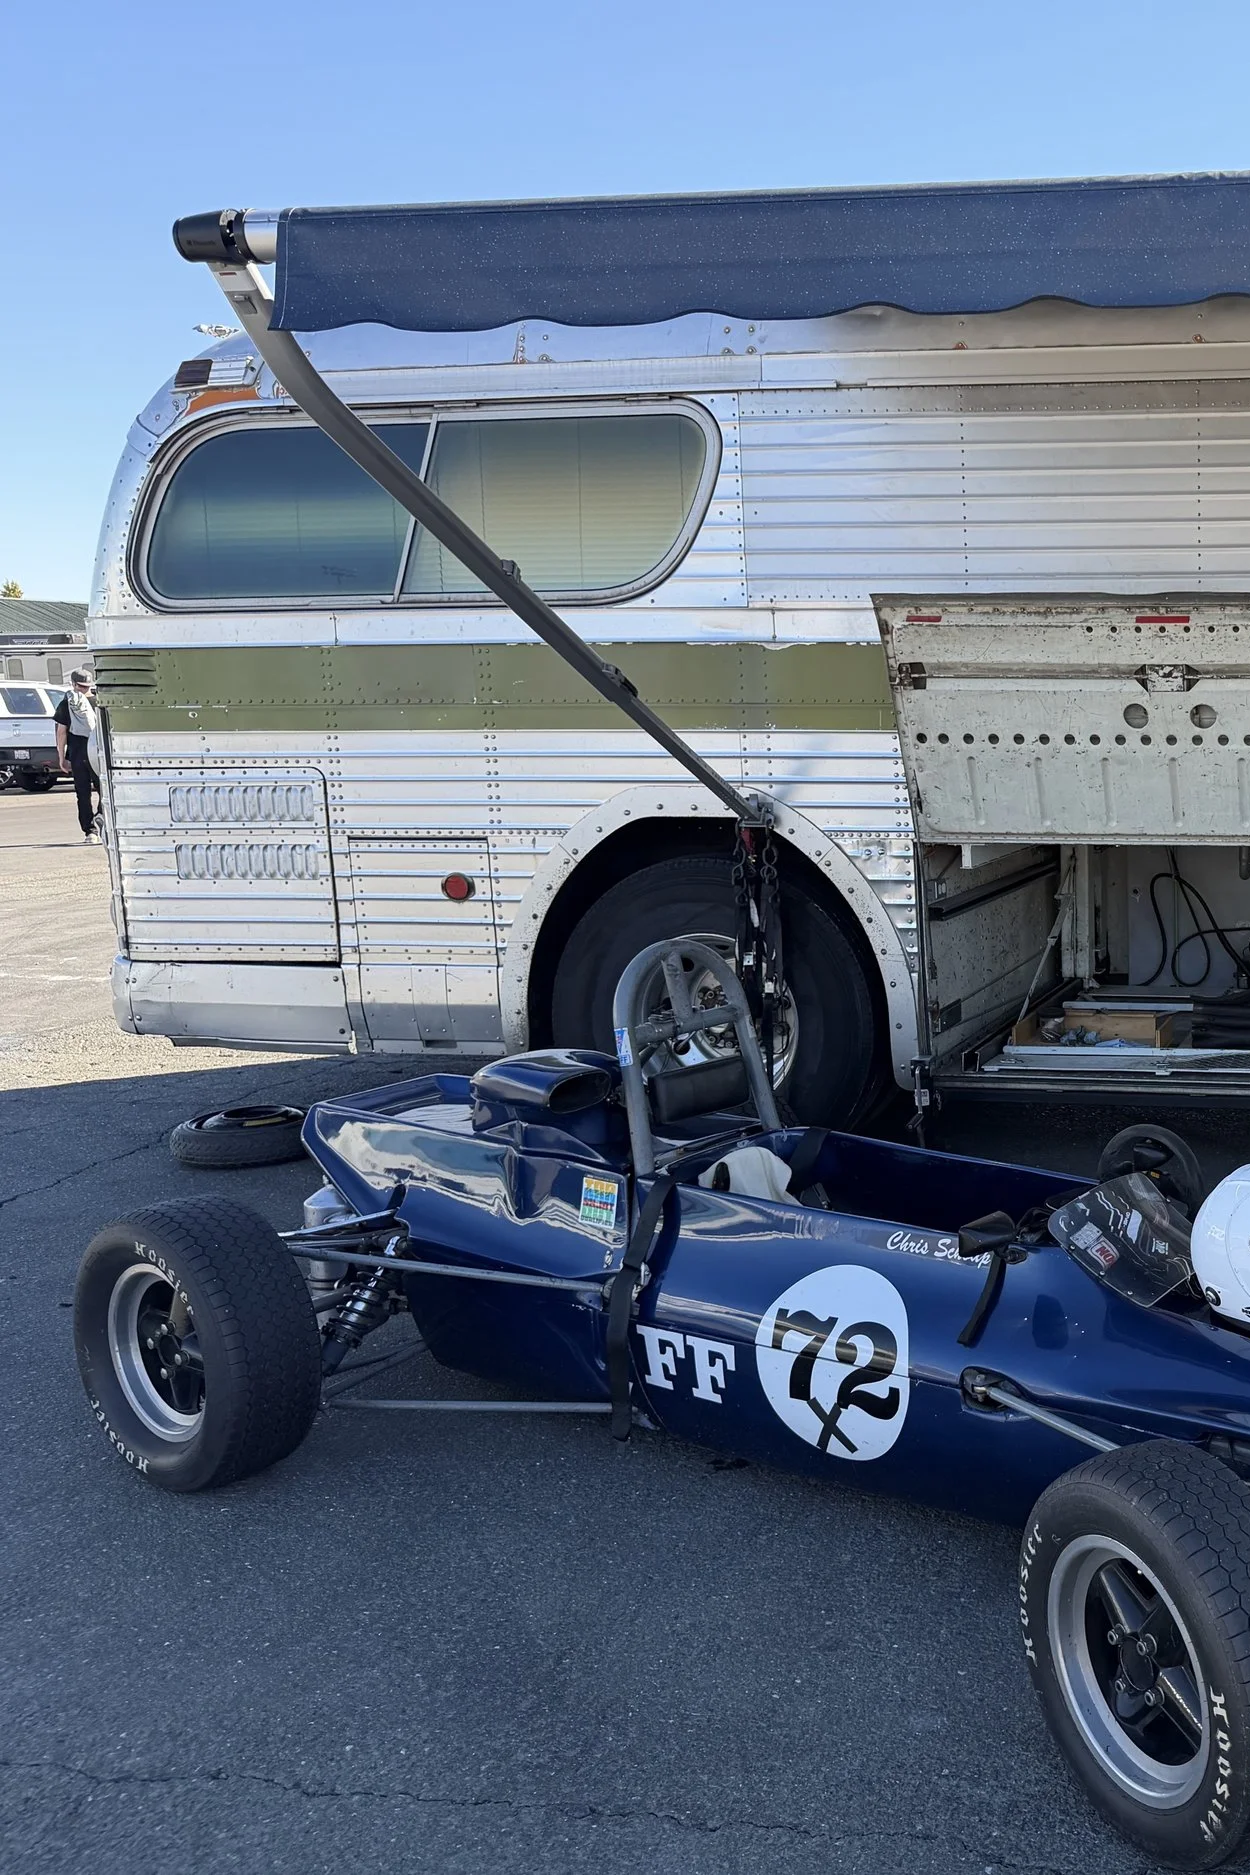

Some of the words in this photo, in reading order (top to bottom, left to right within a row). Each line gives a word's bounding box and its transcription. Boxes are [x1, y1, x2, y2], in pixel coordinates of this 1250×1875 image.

[134, 1241, 194, 1315] Hoosier
[886, 1231, 929, 1254] Chris
[636, 1324, 735, 1404] FF
[771, 1307, 900, 1420] 72
[90, 1399, 149, 1473] Hoosier
[806, 1396, 859, 1454] X
[1019, 1523, 1043, 1668] Hoosier
[1200, 1684, 1232, 1844] Hoosier
